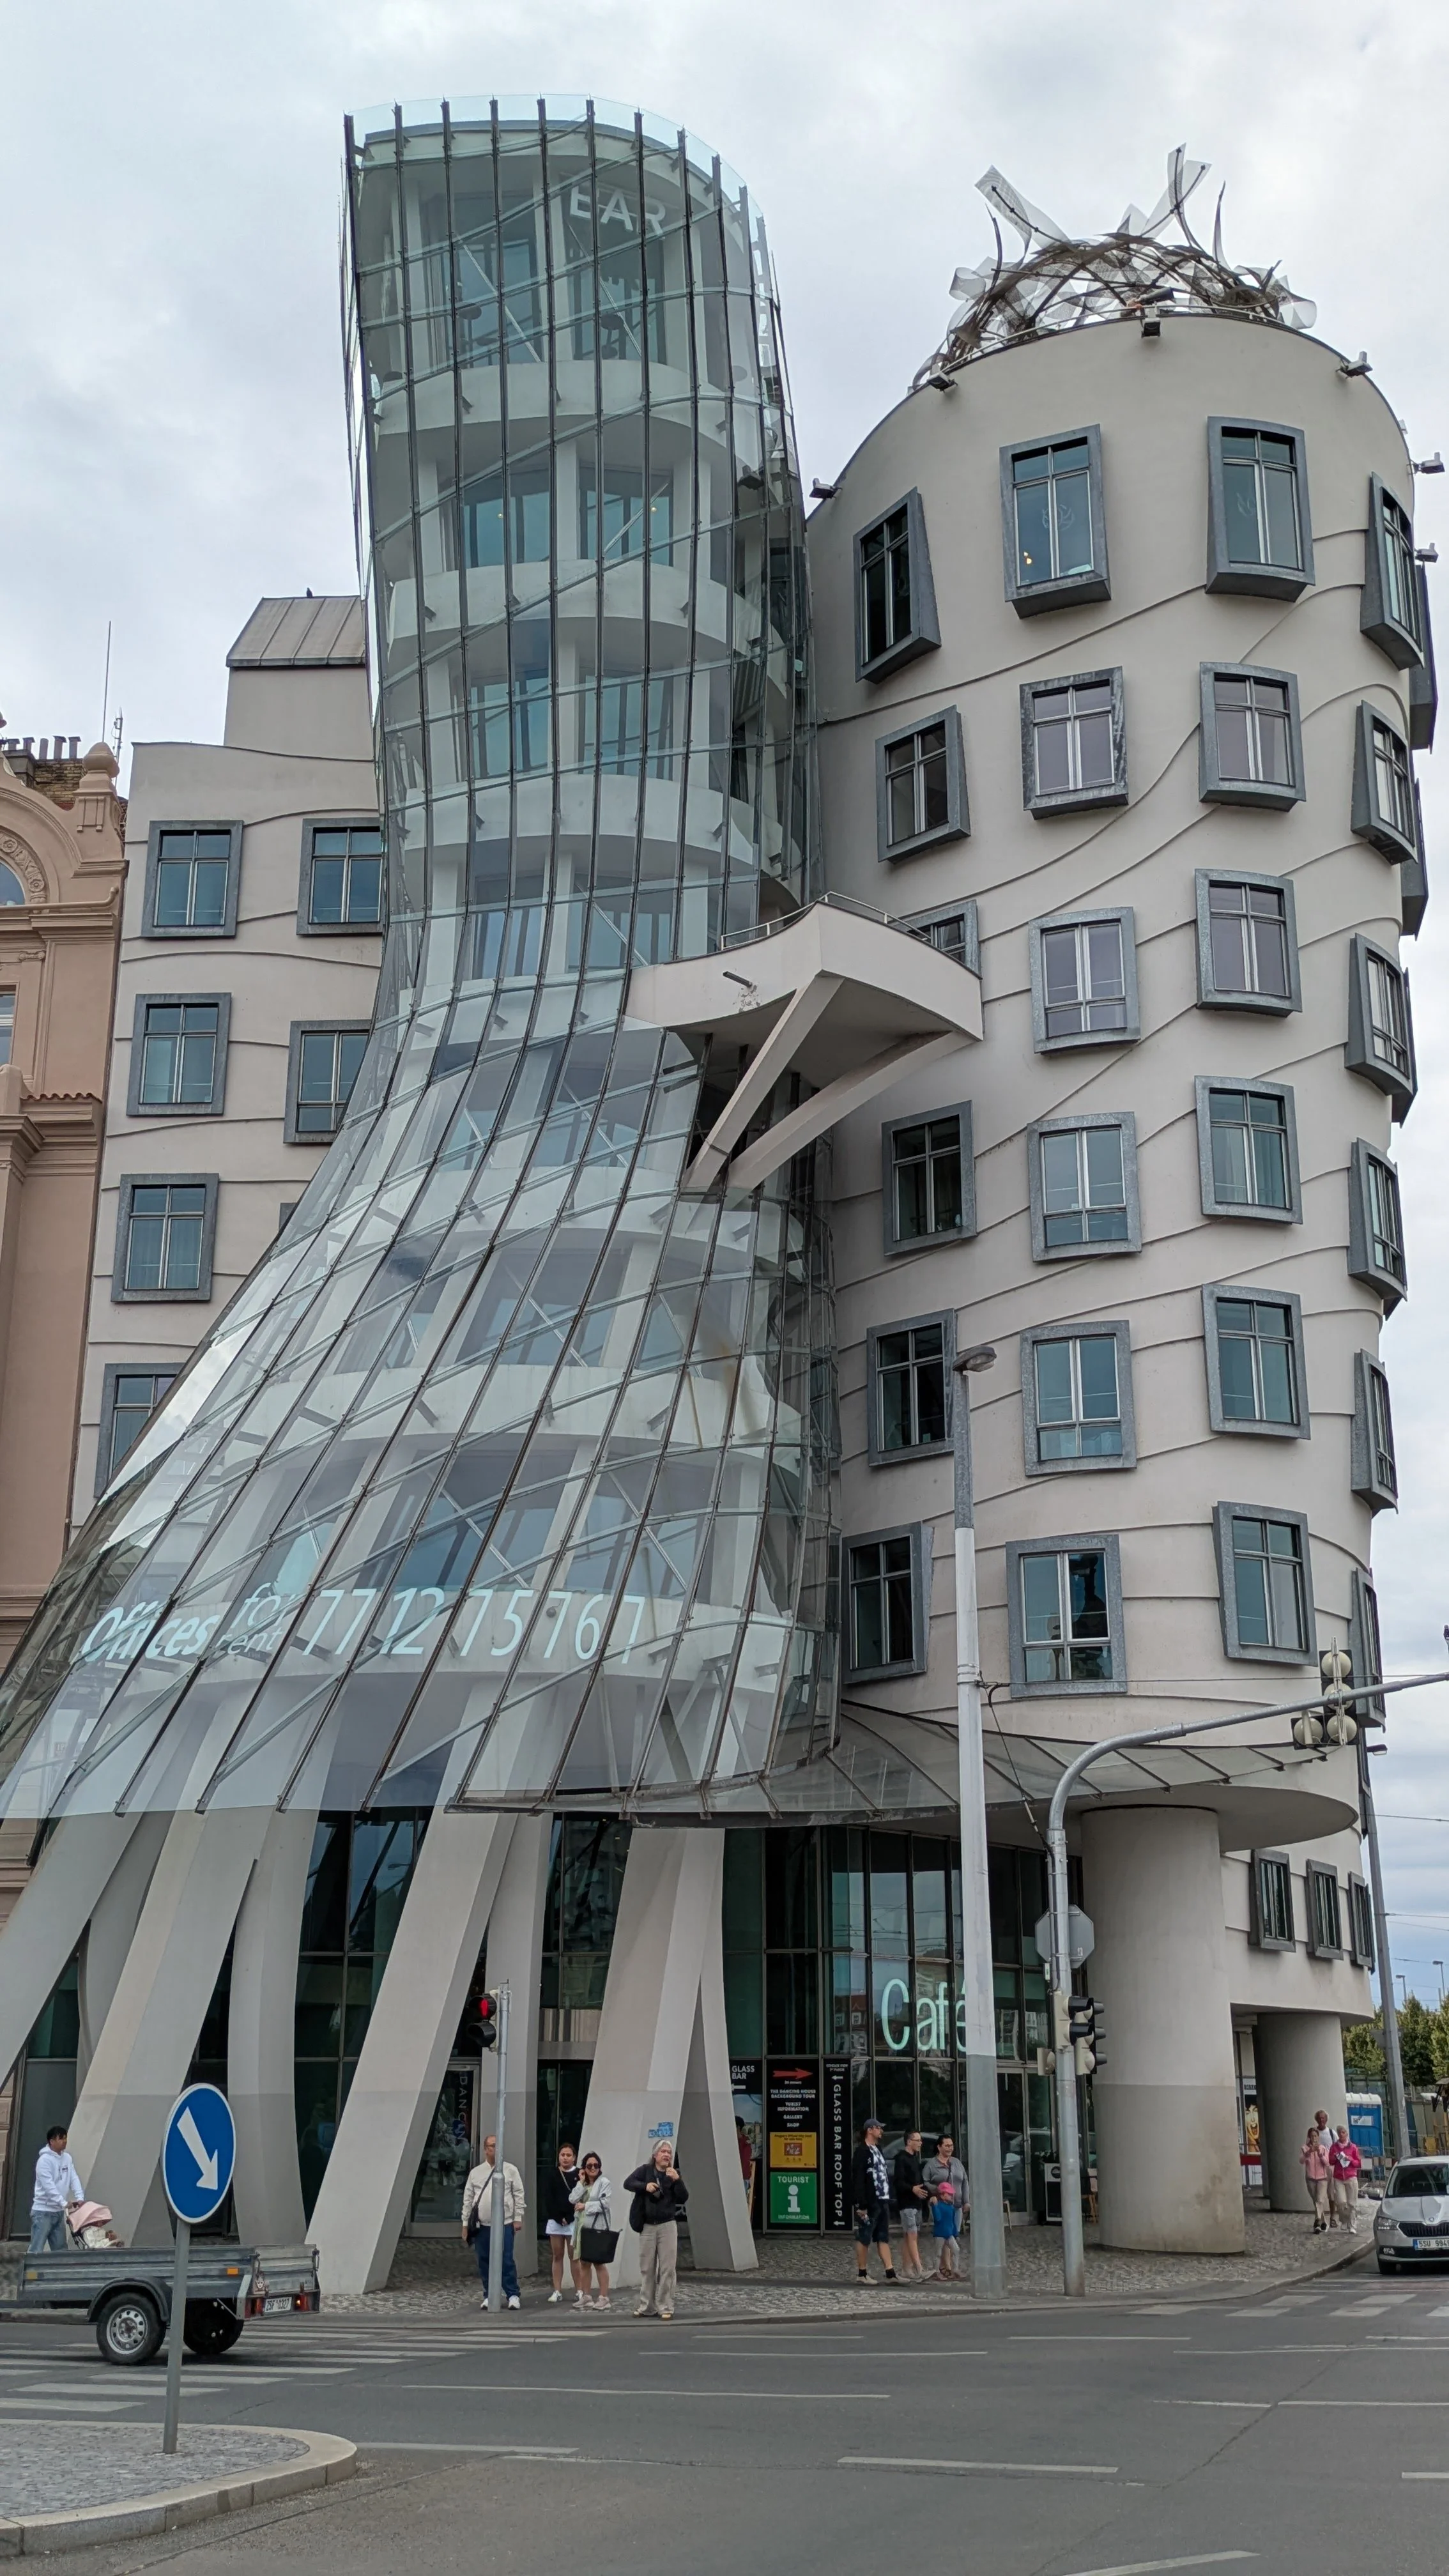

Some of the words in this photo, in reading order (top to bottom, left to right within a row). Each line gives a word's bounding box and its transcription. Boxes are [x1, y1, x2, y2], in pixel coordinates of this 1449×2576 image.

[81, 1600, 221, 1662] Offices
[215, 1627, 283, 1655] rent
[833, 2084, 842, 2122] GLASS
[834, 2126, 842, 2149] BAR
[778, 2175, 809, 2184] TOURIST
[834, 2154, 843, 2188] ROOF
[834, 2192, 843, 2217] TOP
